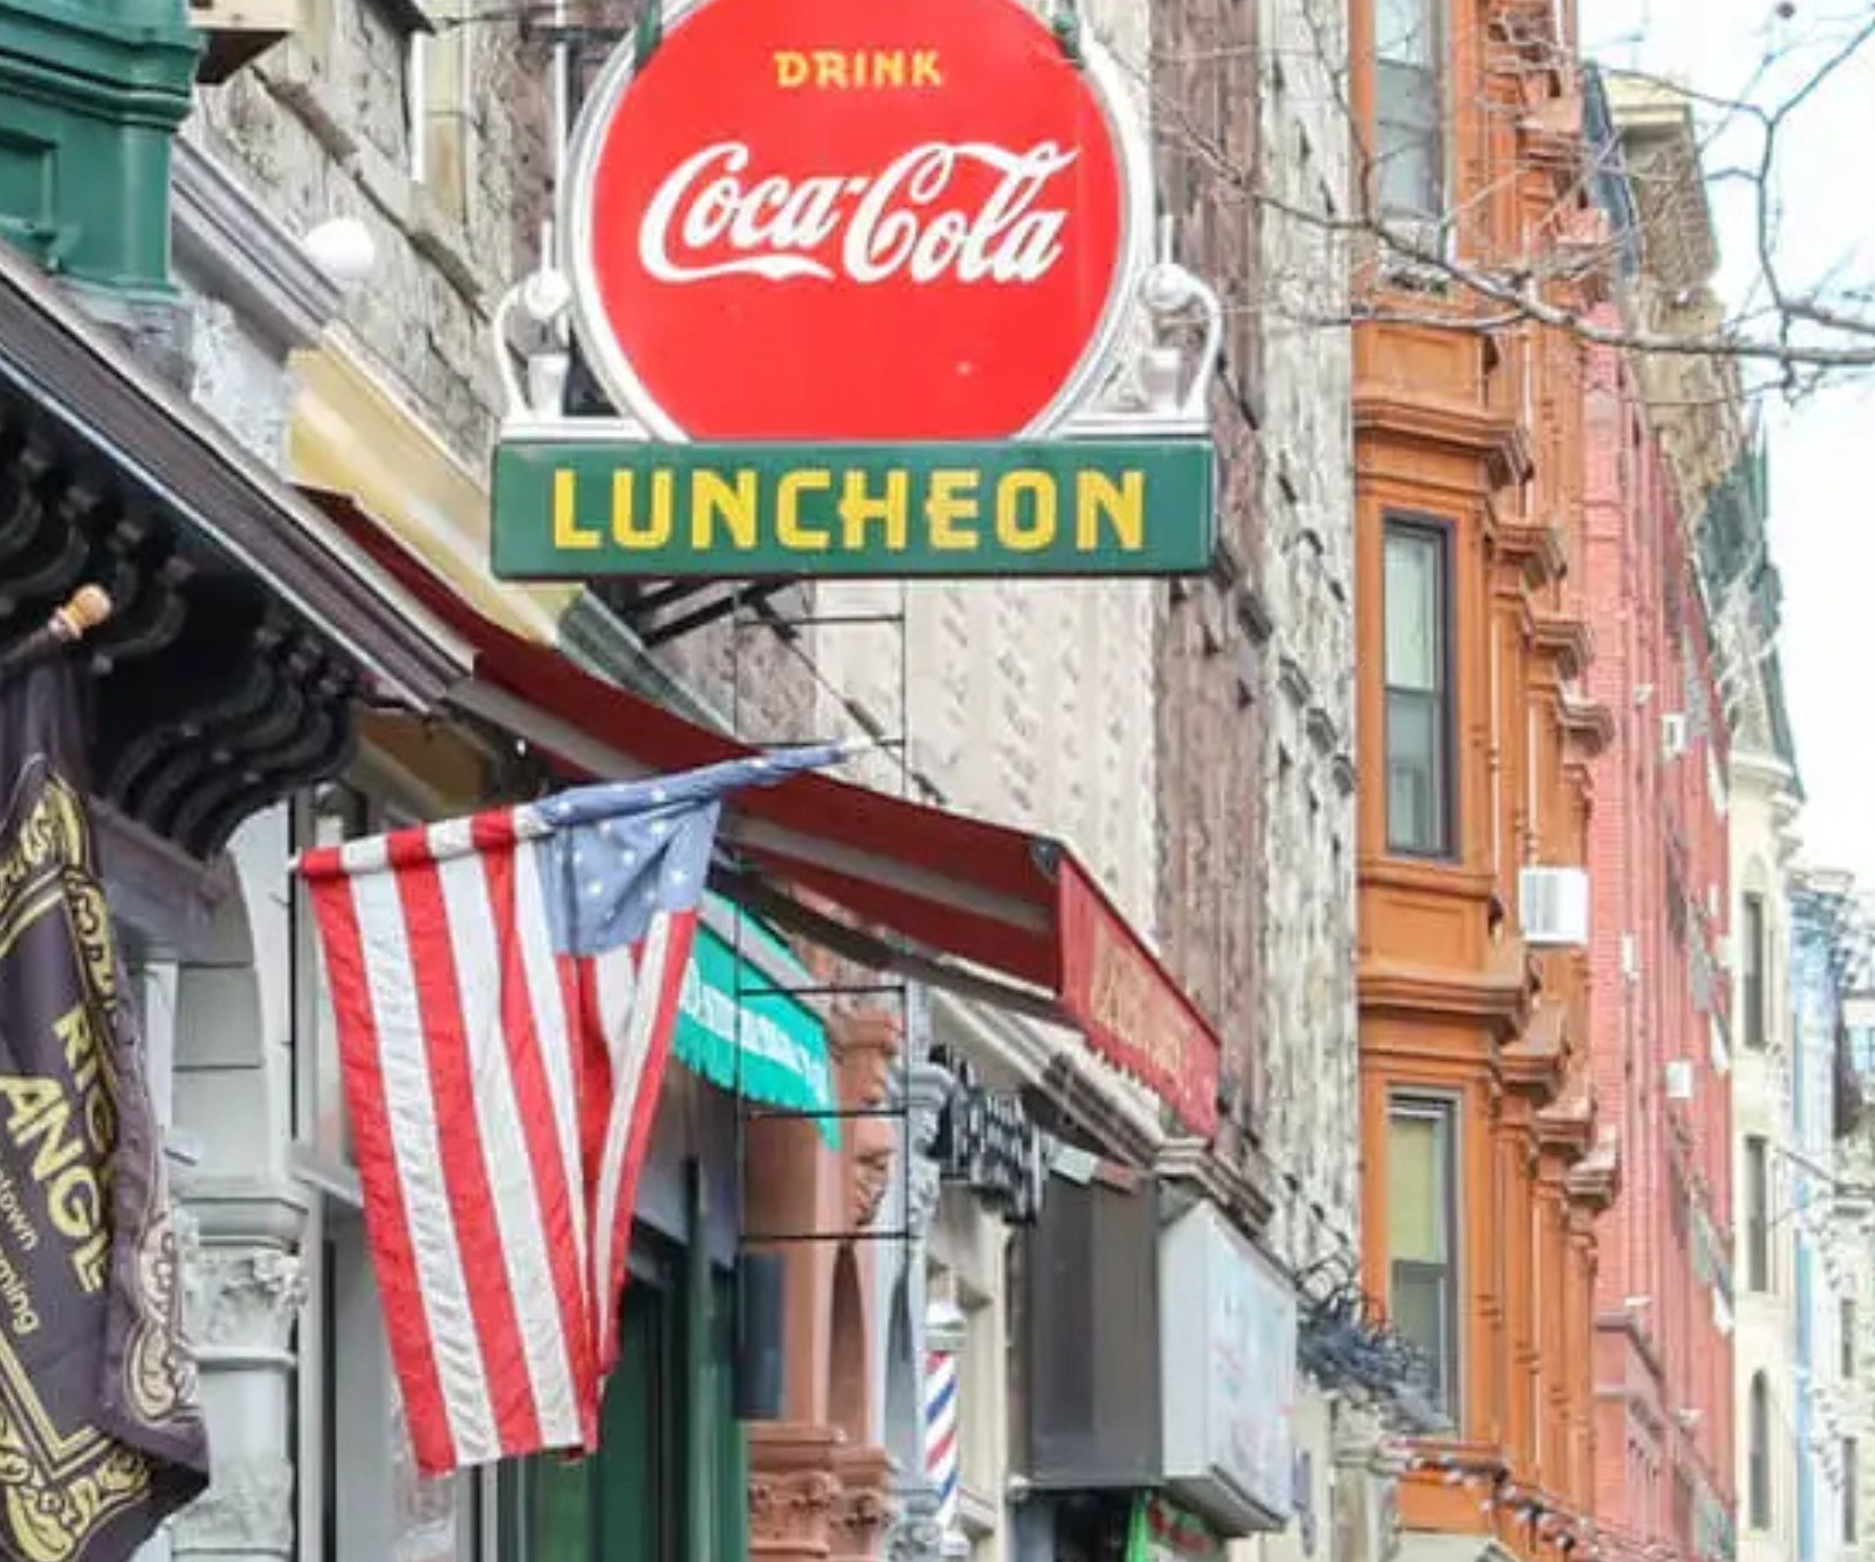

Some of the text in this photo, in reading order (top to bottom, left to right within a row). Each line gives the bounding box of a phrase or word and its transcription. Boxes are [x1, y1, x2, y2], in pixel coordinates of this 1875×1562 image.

[773, 48, 945, 88] DRINK
[637, 139, 1081, 284] Coca-Cola
[552, 467, 1146, 551] LUNCHEON
